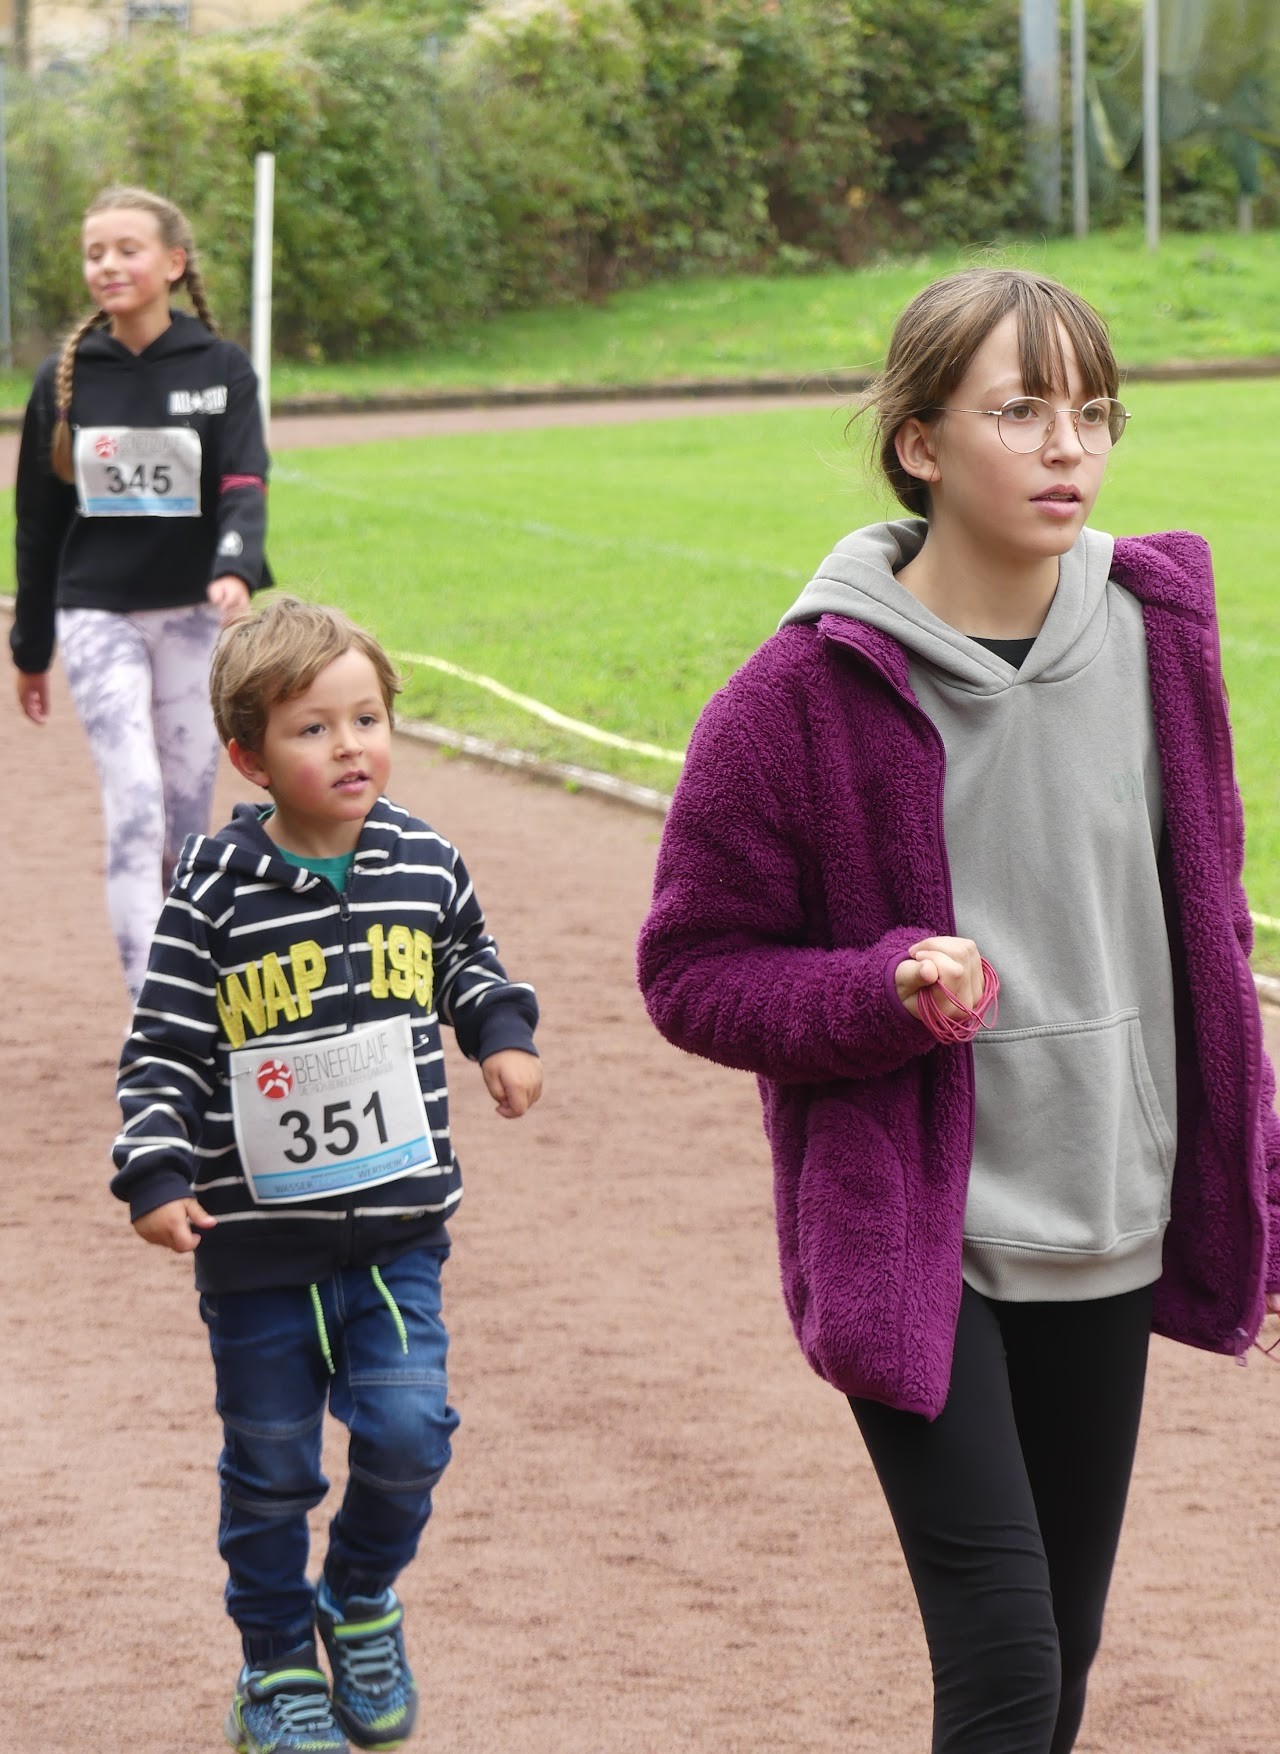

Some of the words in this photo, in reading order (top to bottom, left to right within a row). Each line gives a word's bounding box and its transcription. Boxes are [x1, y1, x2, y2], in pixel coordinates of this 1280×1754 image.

[105, 464, 171, 495] 345
[215, 939, 327, 1050] WAP
[293, 1032, 390, 1085] BENEFIZLAUF
[279, 1090, 389, 1164] 351
